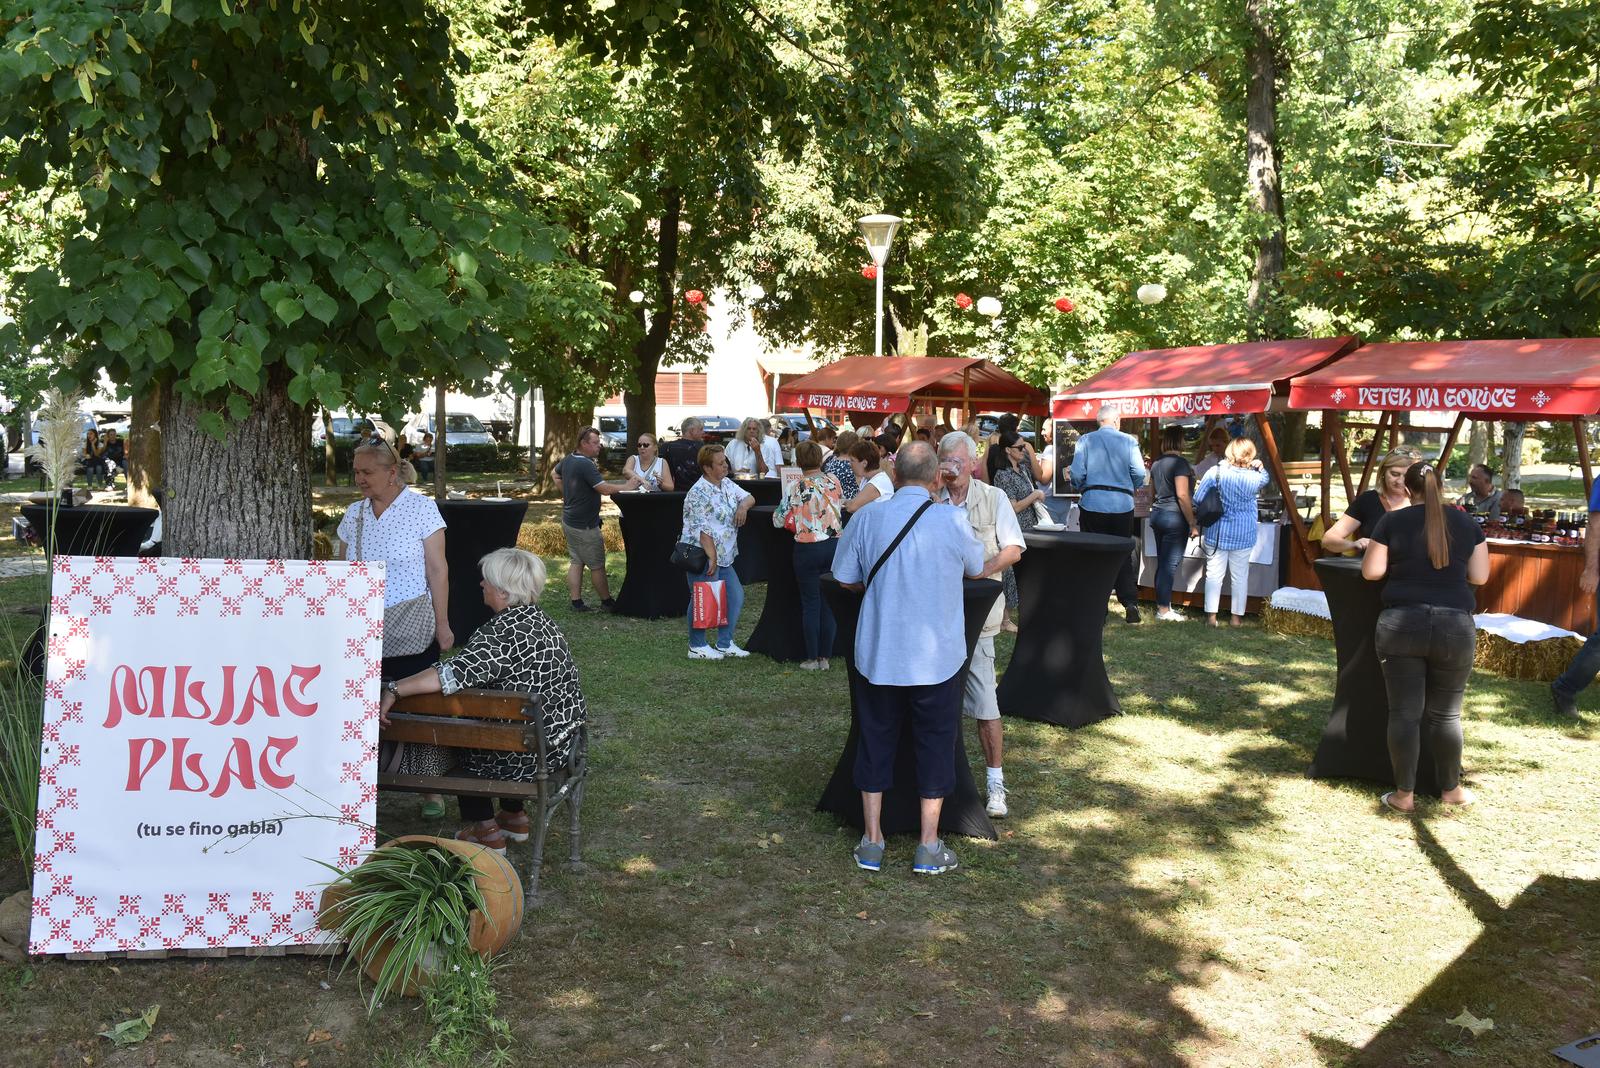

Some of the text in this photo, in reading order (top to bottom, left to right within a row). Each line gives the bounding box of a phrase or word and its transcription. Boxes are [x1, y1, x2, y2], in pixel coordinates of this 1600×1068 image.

[808, 394, 834, 407] PETEK
[1141, 397, 1159, 415] NA
[1358, 387, 1411, 407] PETEK
[1416, 387, 1440, 409] NA
[102, 664, 322, 729] MLJAC
[124, 735, 299, 799] PLAC
[136, 820, 283, 839] (tu se fino gabla)
